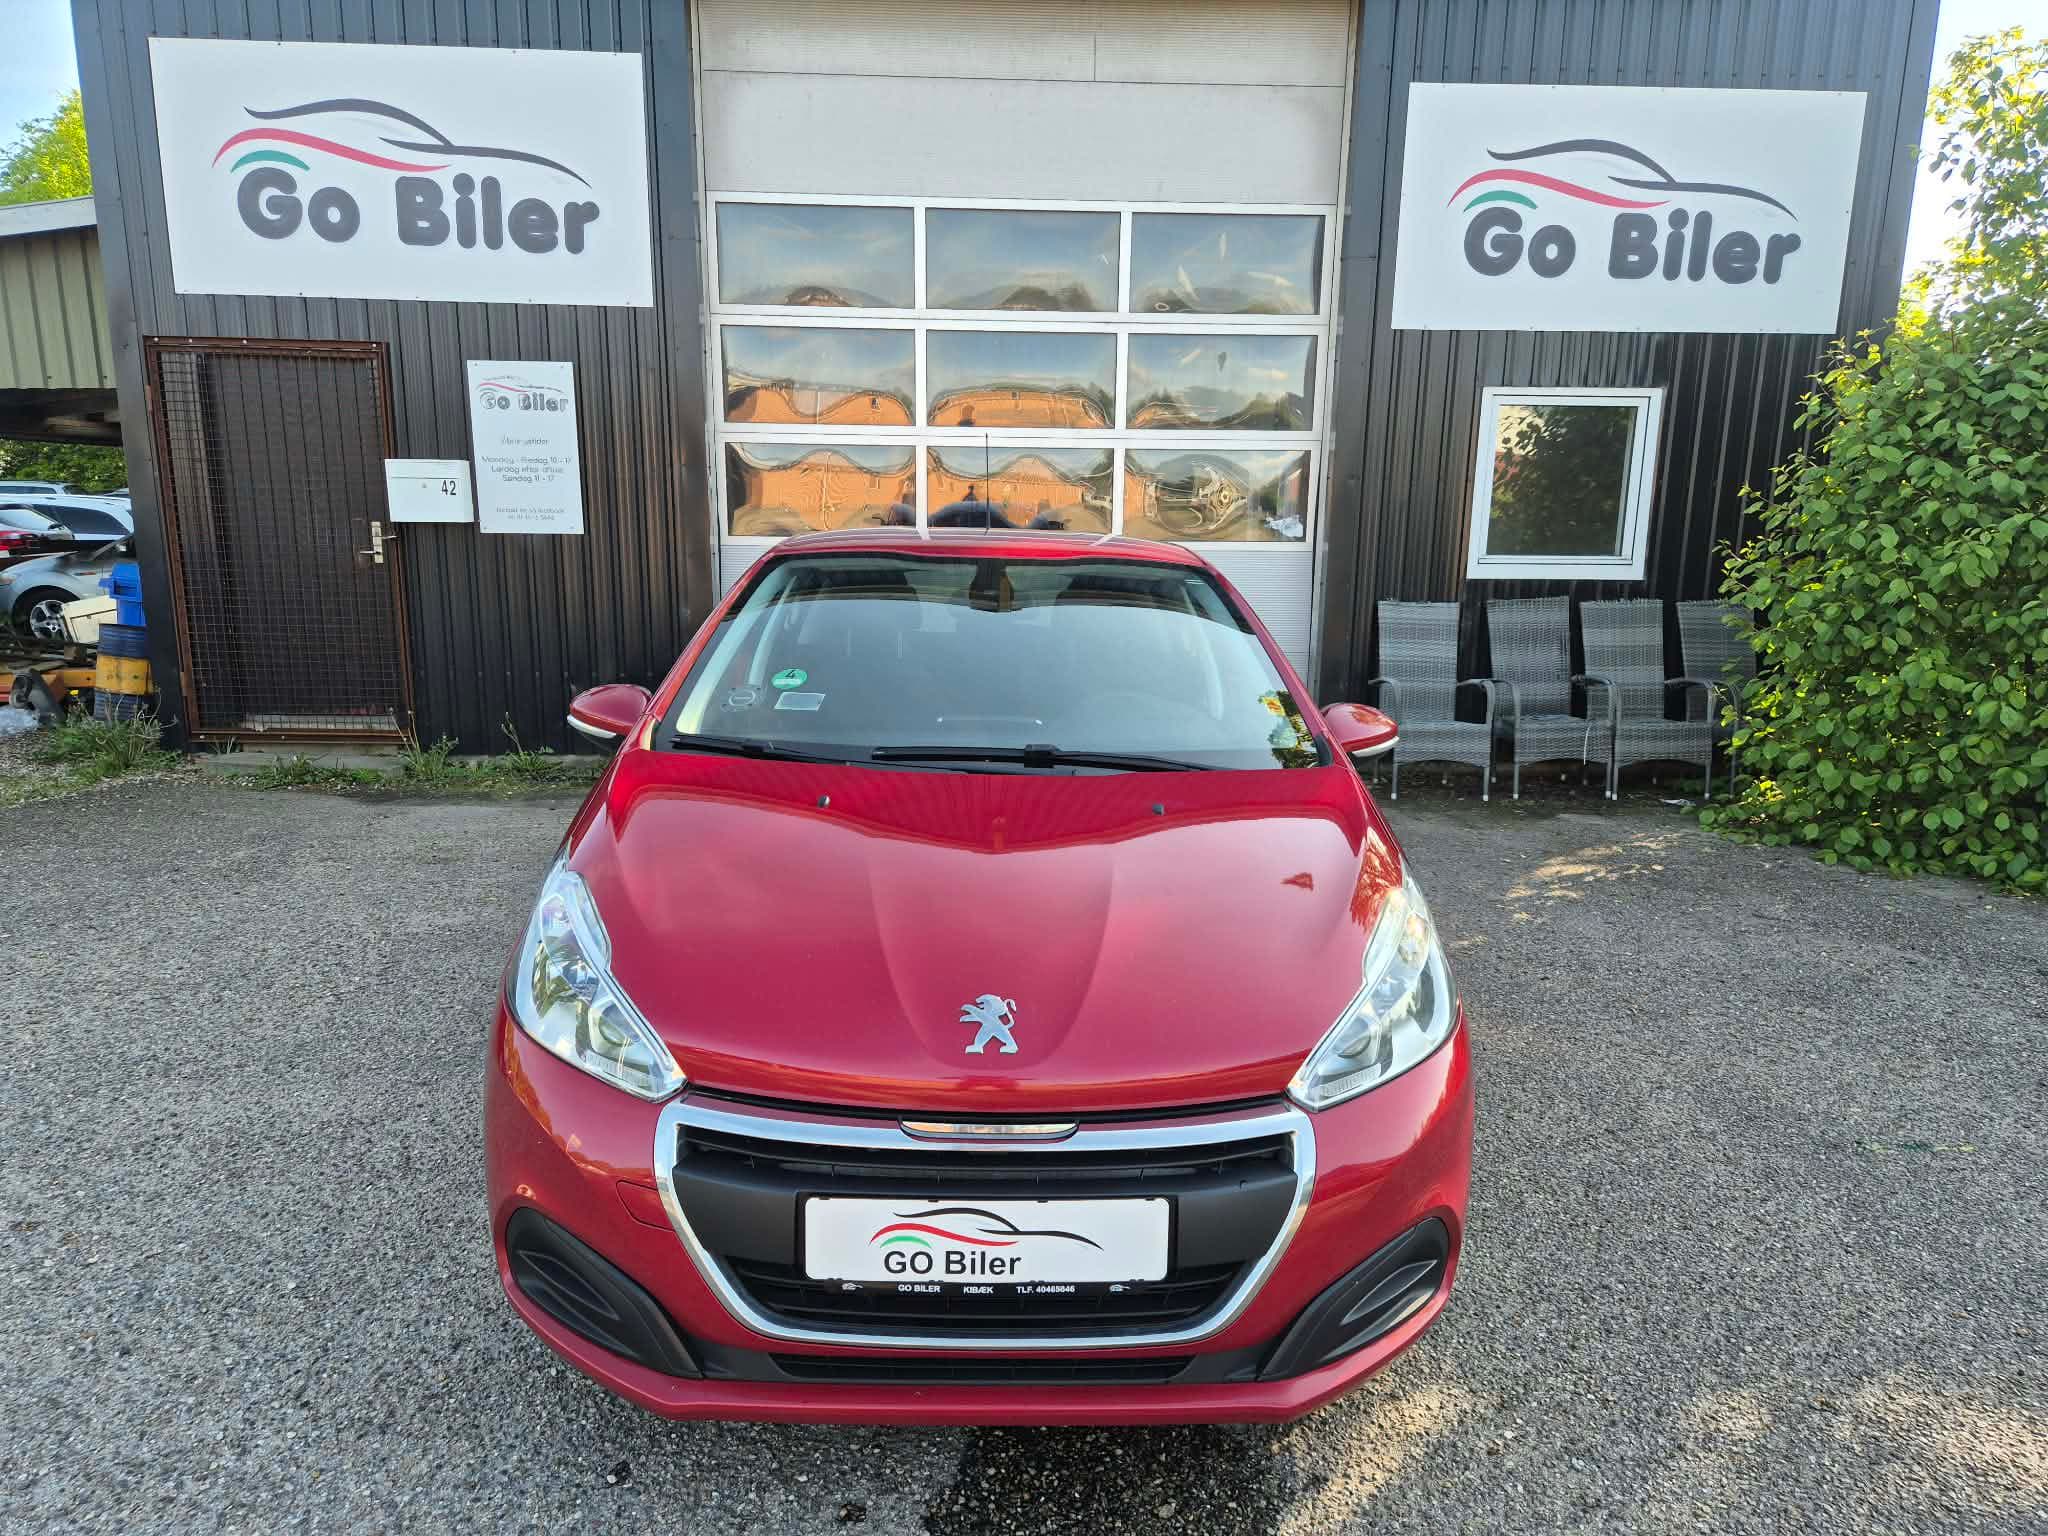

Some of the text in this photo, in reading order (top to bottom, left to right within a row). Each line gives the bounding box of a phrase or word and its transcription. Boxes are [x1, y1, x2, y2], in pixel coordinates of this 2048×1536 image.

[237, 167, 600, 255] Go Biler
[1463, 207, 1801, 285] Go Biler
[479, 391, 569, 412] Go Biler
[441, 480, 457, 496] 42
[784, 669, 796, 680] 4
[884, 1250, 1022, 1275] GO Biler
[898, 1284, 912, 1292] GO
[913, 1284, 941, 1293] BILER
[1016, 1286, 1034, 1294] TLF.
